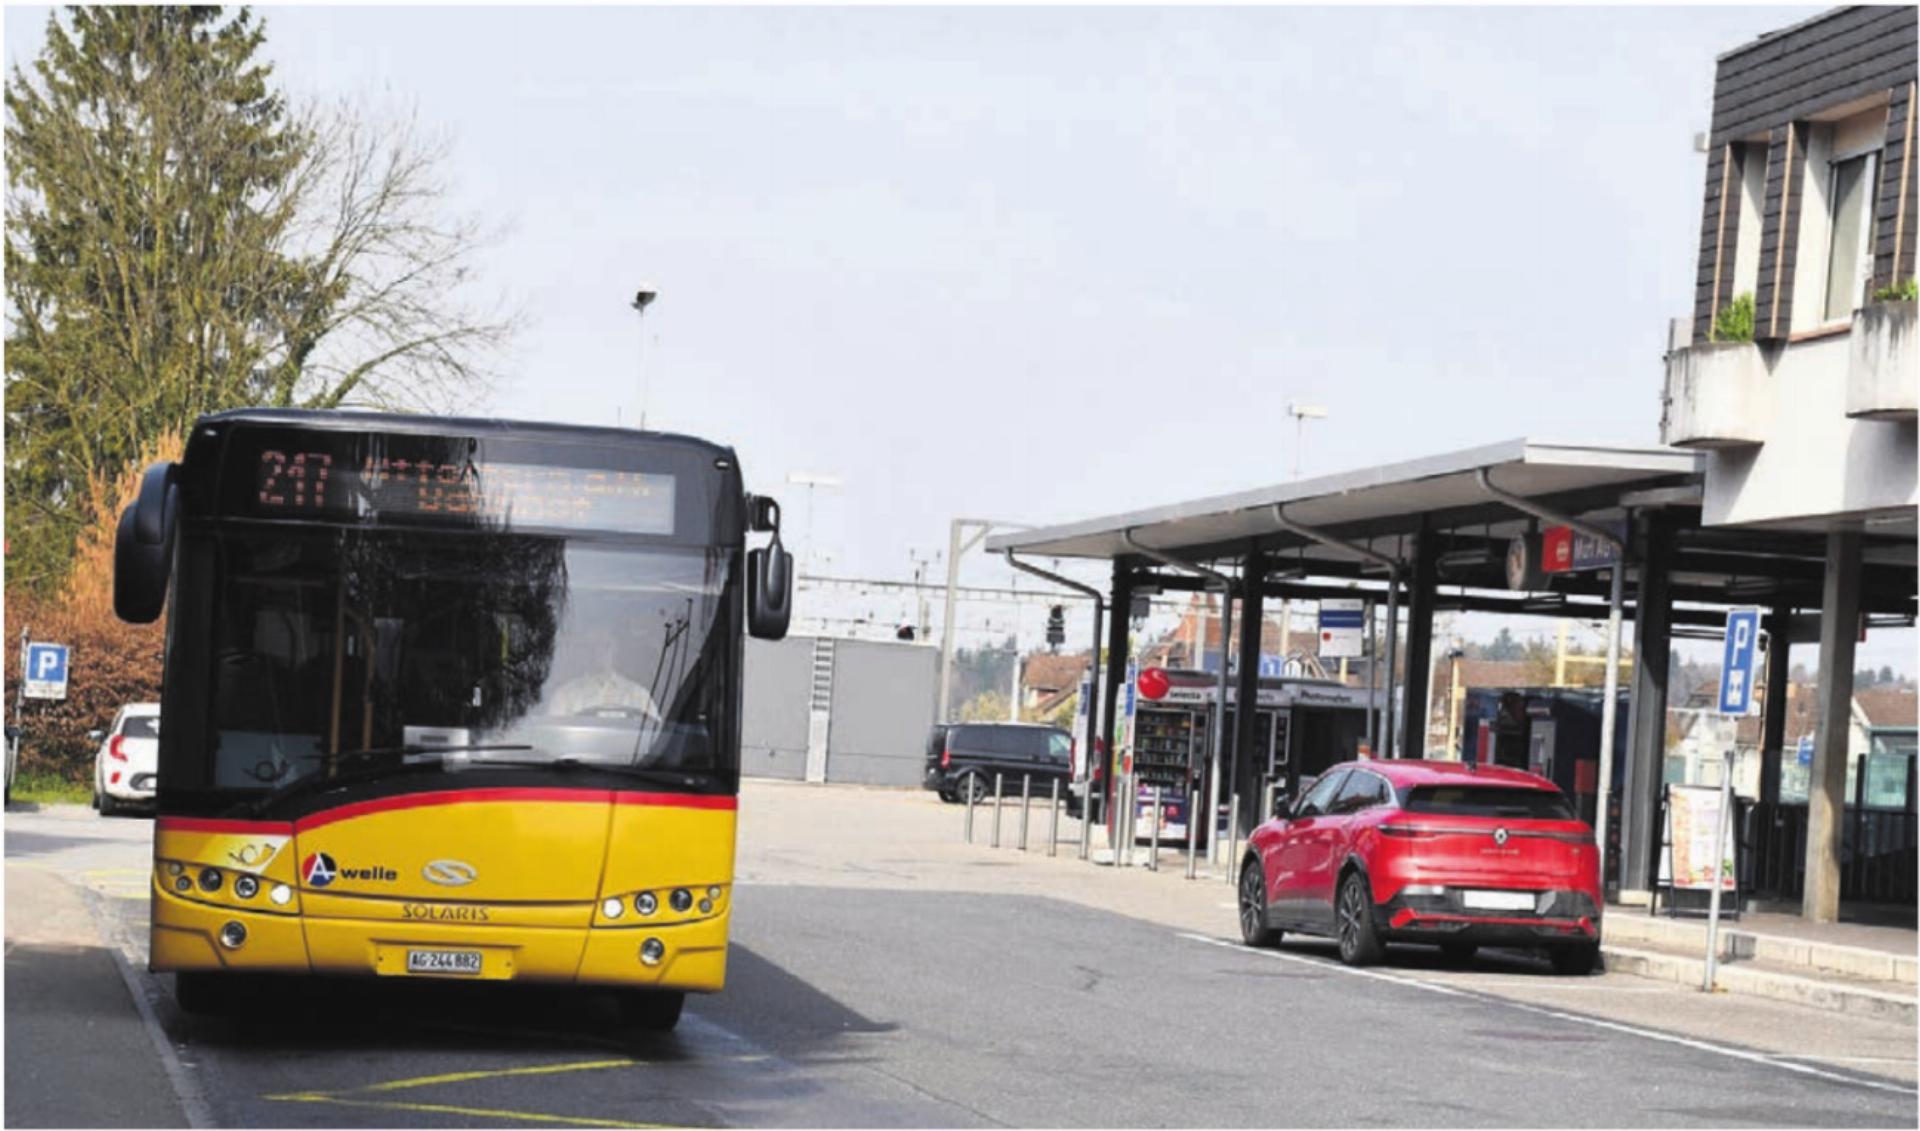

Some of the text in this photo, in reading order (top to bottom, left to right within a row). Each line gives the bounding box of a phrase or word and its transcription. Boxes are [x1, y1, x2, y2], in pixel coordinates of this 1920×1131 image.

[260, 452, 331, 506] 217
[1731, 619, 1749, 667] P
[38, 650, 58, 679] P
[340, 865, 397, 881] welle
[402, 904, 489, 921] SOLARIS
